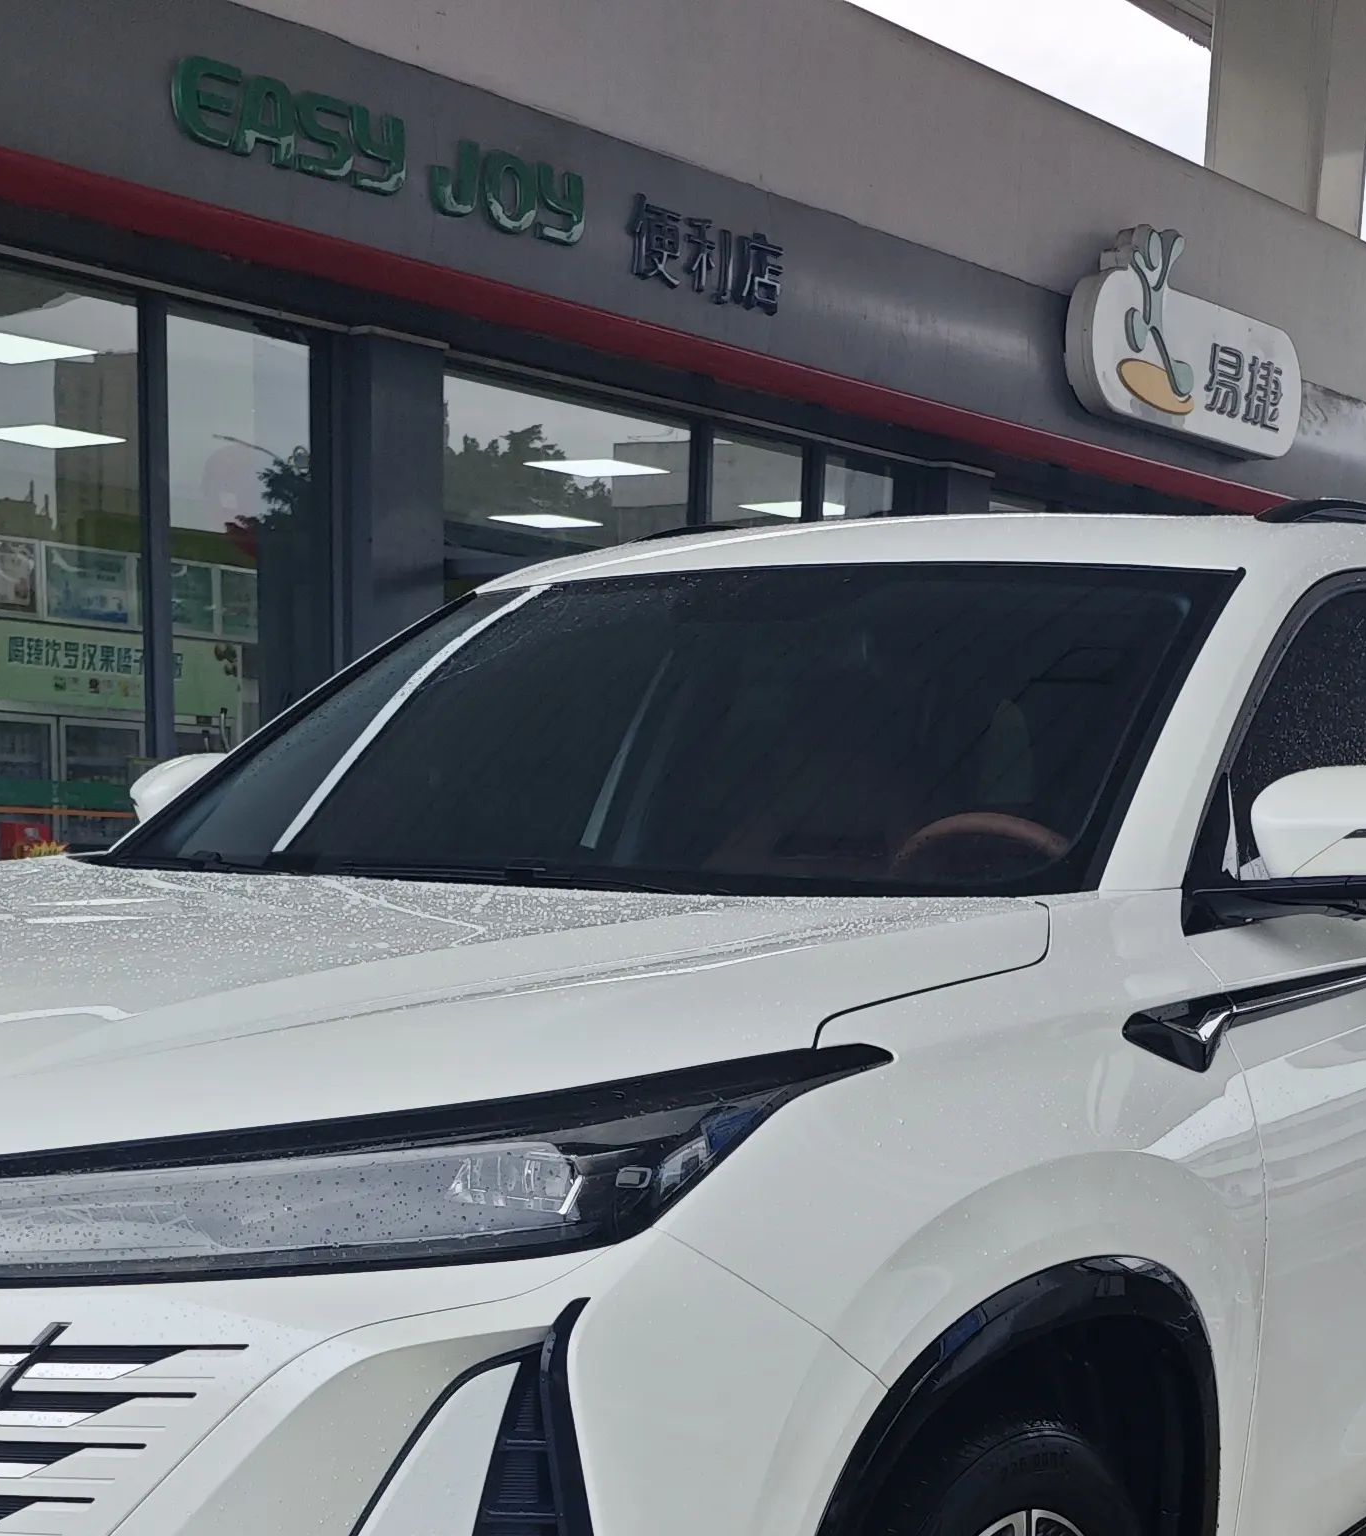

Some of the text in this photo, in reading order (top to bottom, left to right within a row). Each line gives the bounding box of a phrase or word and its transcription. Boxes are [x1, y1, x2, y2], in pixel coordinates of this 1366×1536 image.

[171, 55, 585, 246] EASY JOY
[627, 193, 785, 316] 便利店
[1203, 342, 1283, 433] 易捷
